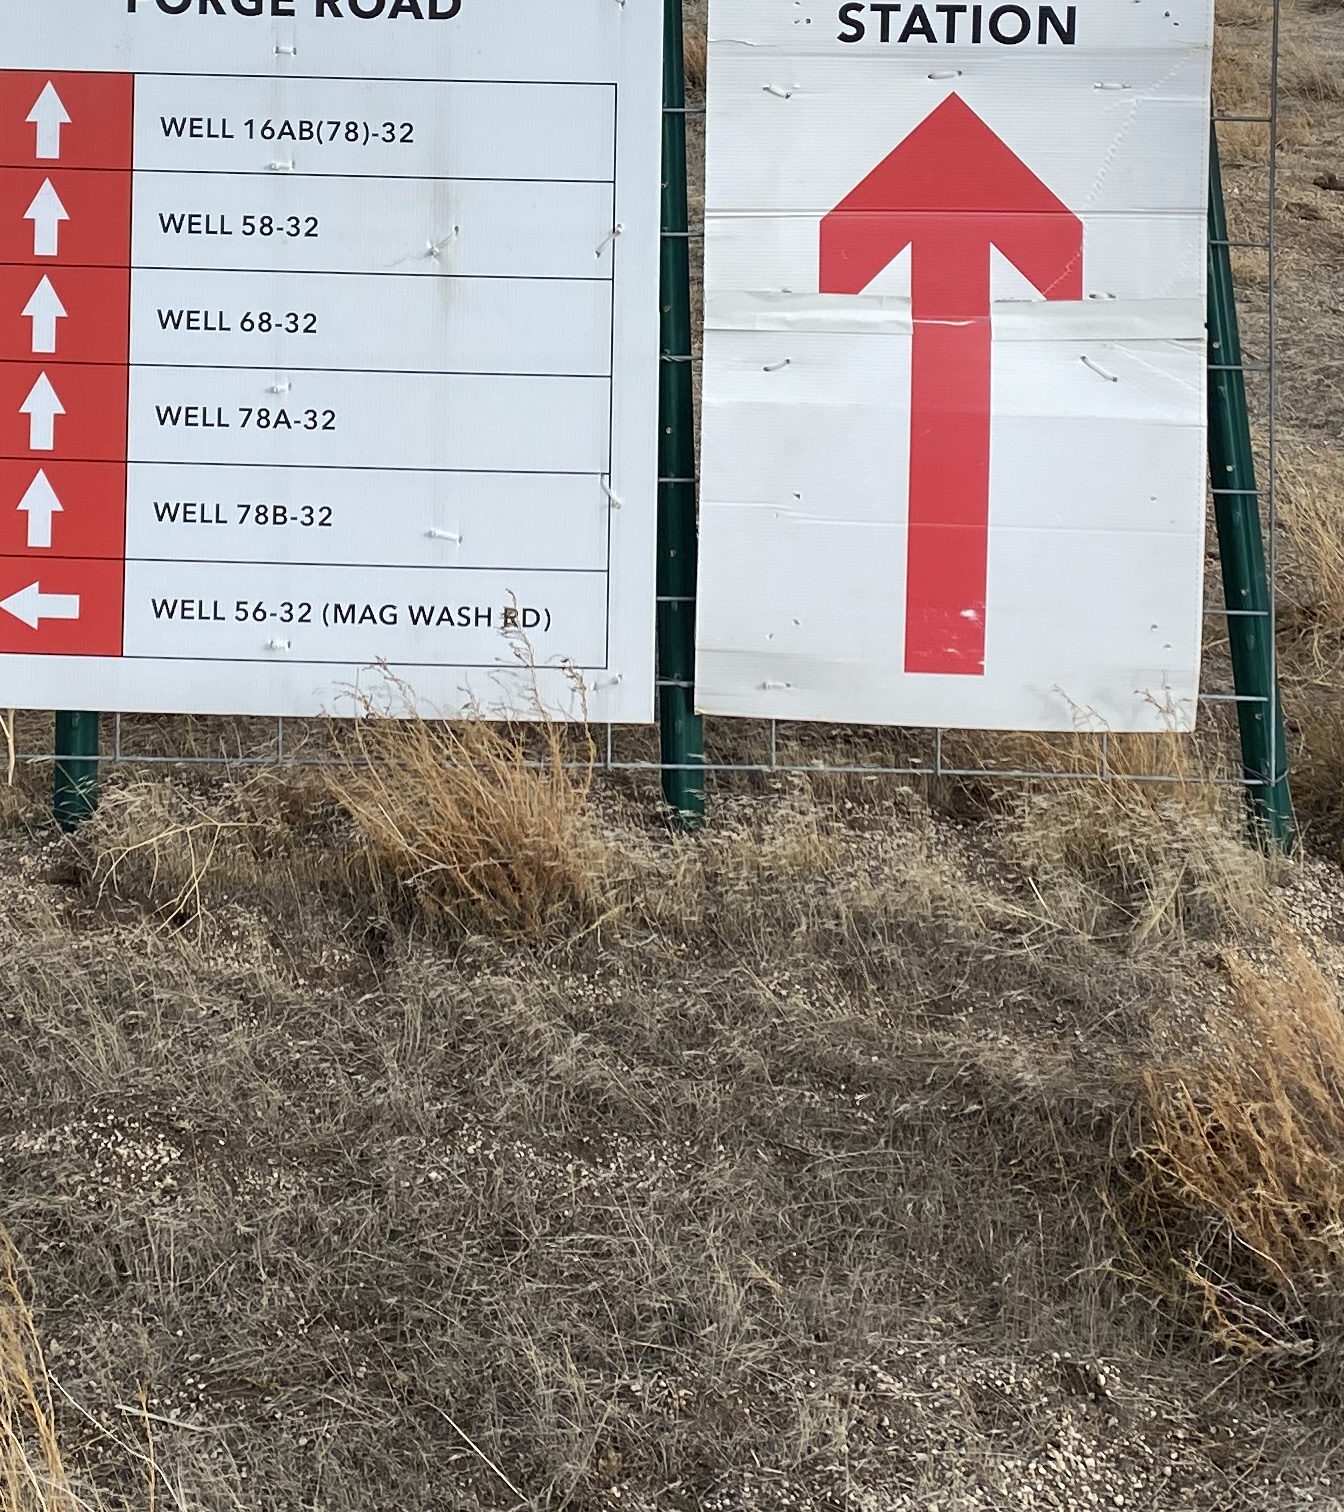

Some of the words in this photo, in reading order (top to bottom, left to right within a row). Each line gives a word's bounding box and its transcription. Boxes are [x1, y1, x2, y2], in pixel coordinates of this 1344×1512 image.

[836, 2, 1077, 46] STATION
[159, 116, 235, 139] WELL
[243, 118, 414, 146] 16AB(78)-32
[158, 212, 233, 236] WELL
[241, 215, 319, 238] 58-32
[156, 309, 232, 332] WELL
[240, 311, 317, 334] 68-32
[155, 405, 230, 428] WELL
[238, 407, 336, 431] 78A-32
[153, 501, 228, 524] WELL
[236, 504, 333, 527] 78B-32
[151, 598, 226, 621] WELL
[234, 600, 312, 623] 56-32
[322, 602, 398, 628] (MAG
[407, 605, 492, 628] WASH
[504, 607, 551, 632] RD)
